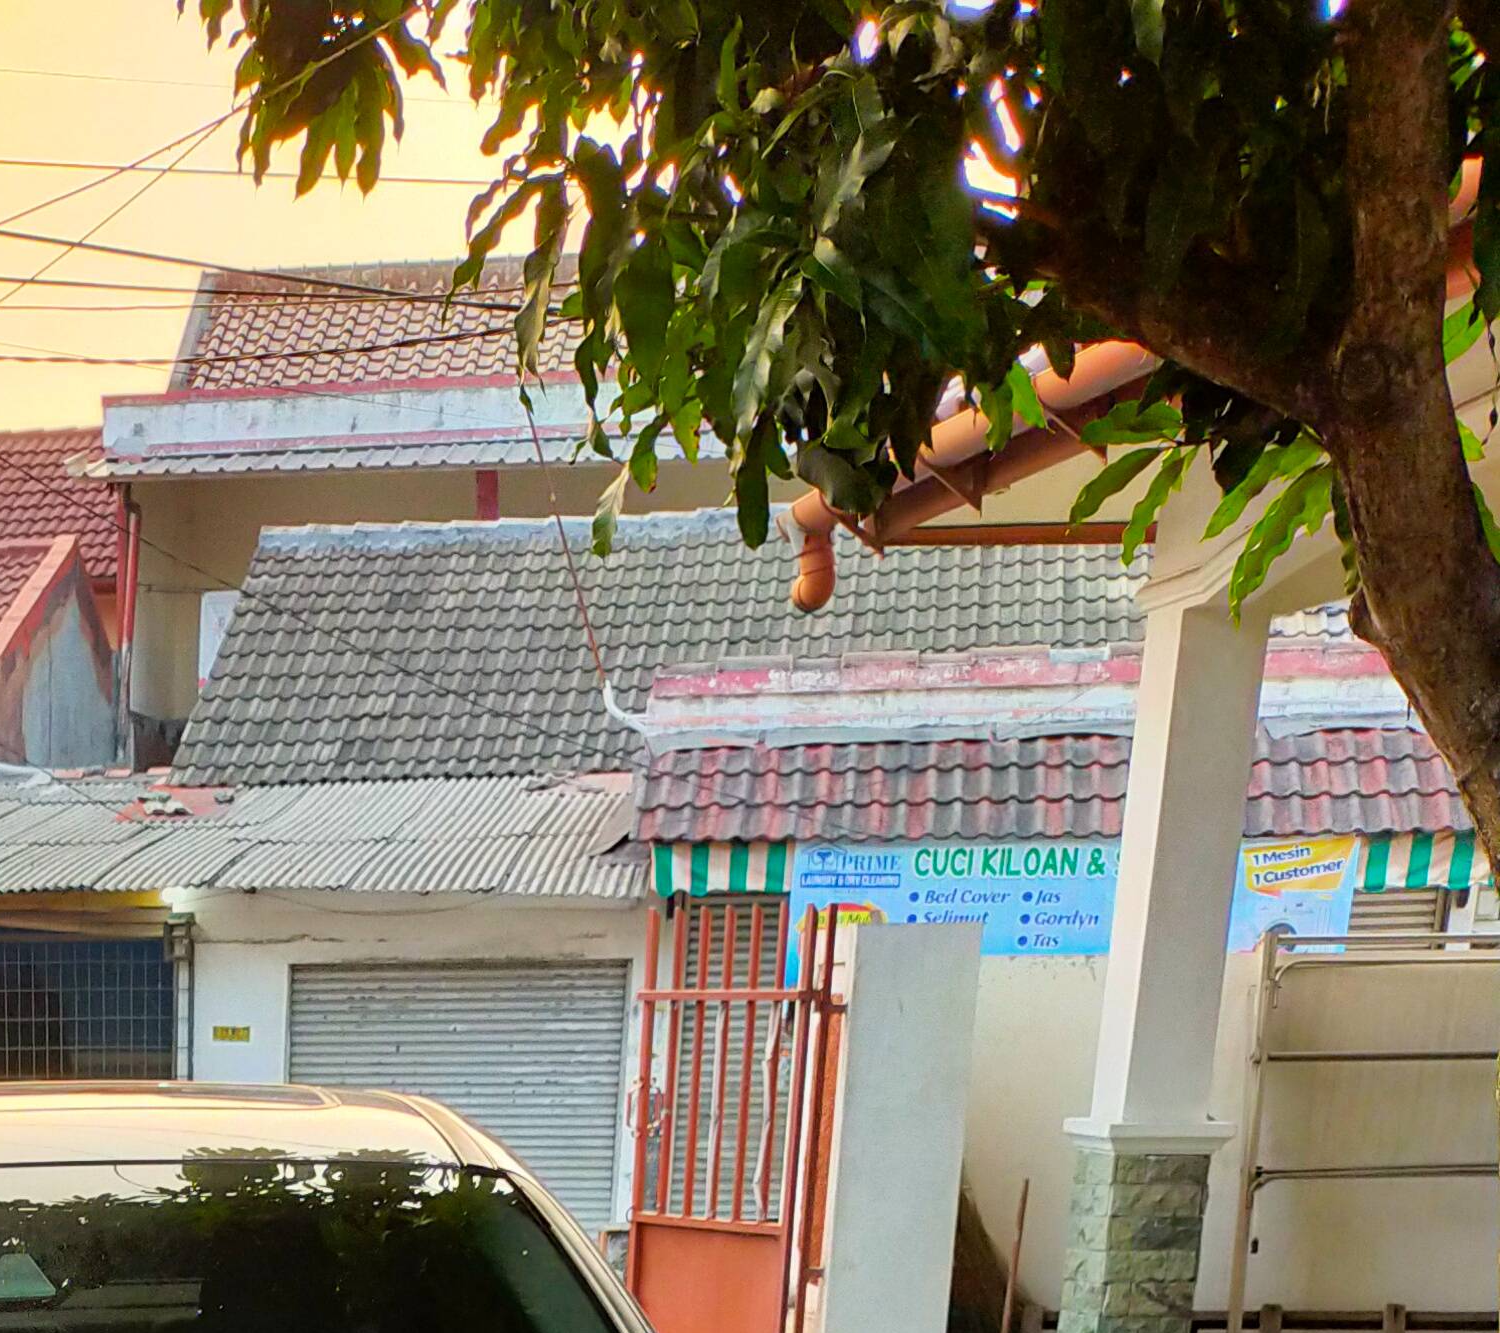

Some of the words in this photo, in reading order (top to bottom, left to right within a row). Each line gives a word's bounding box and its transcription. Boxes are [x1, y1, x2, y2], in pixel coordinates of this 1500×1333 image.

[842, 855, 900, 870] PRIME
[915, 848, 974, 876] CUCI
[981, 848, 1079, 876] KILOAN
[1087, 848, 1105, 876] &
[1253, 854, 1260, 866] 1
[1262, 846, 1311, 862] Mesin
[1254, 873, 1261, 886] 1
[1263, 859, 1343, 884] Customer
[924, 888, 957, 904] Bed
[960, 890, 1011, 904] Cover
[1034, 890, 1061, 905] Jas
[1034, 910, 1100, 930] Gordyn
[1033, 933, 1060, 947] Tas
